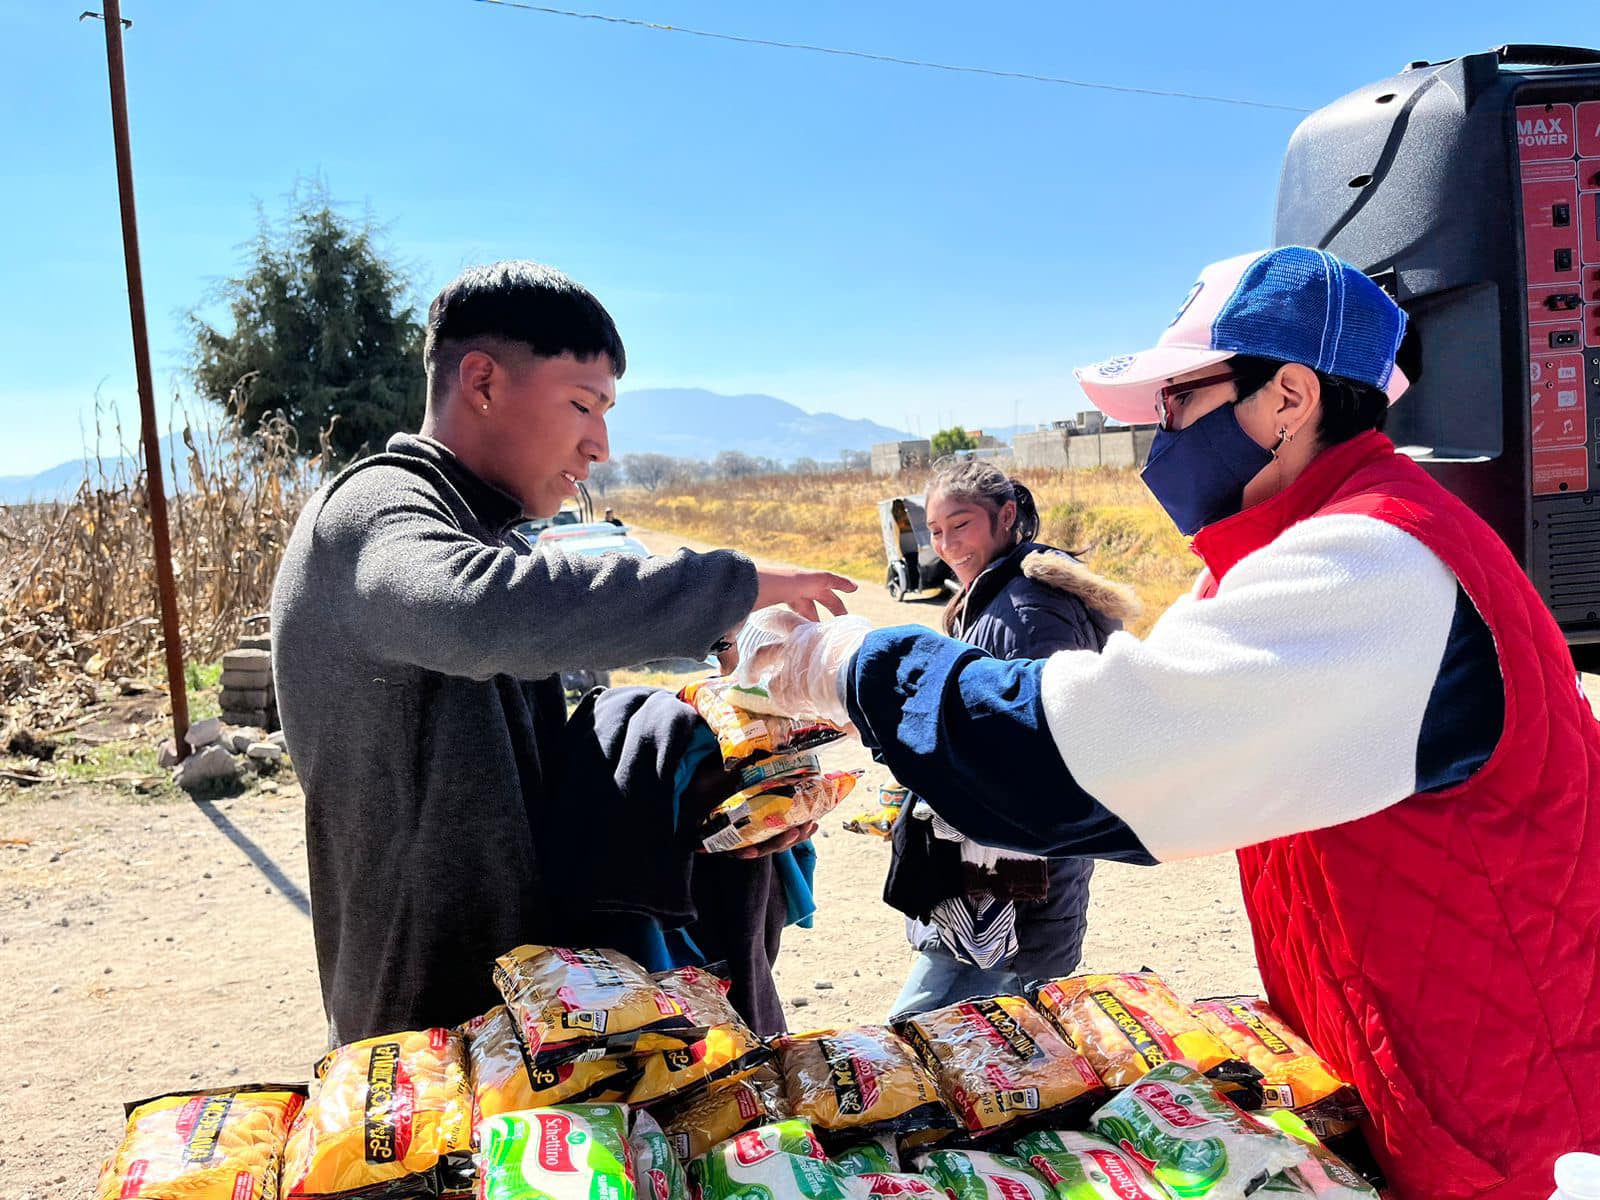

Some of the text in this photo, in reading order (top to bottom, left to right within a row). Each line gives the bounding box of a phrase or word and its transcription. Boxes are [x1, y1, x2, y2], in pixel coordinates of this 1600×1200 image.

[1517, 118, 1563, 136] MAX
[1518, 133, 1568, 147] POWER
[544, 1118, 559, 1167] Schettino
[1099, 1154, 1142, 1200] Schettino
